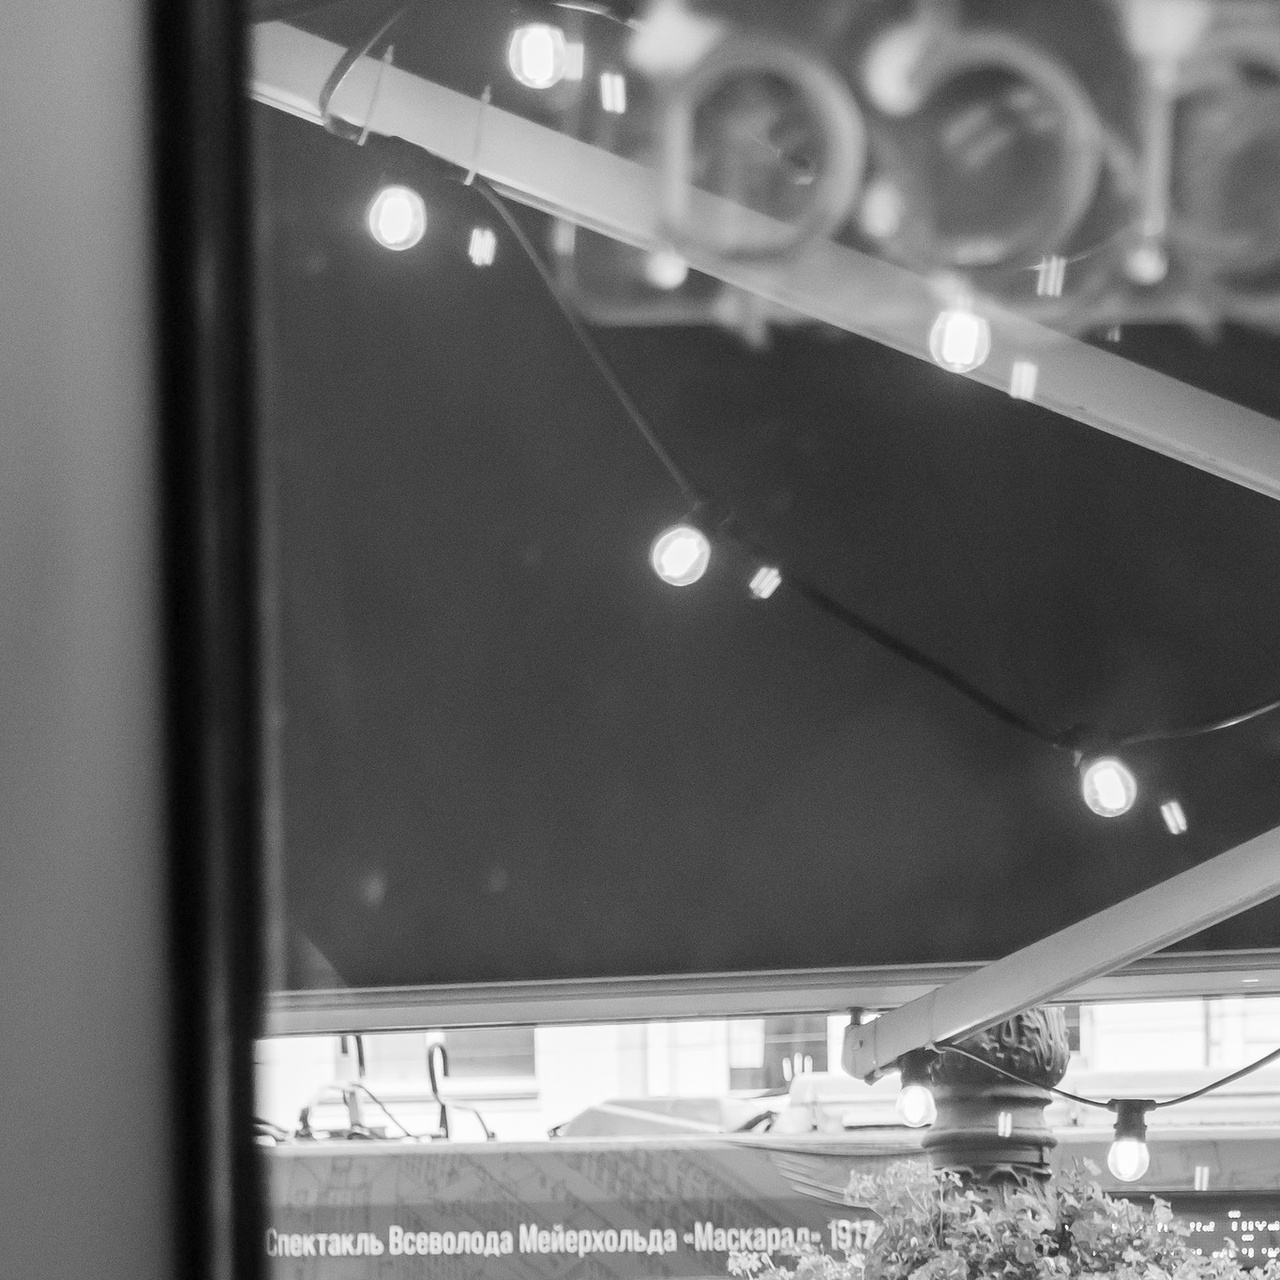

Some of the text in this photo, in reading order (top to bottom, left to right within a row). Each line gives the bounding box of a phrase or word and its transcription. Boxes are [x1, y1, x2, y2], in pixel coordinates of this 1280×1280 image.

[265, 1228, 385, 1257] Спектакль
[388, 1224, 514, 1258] Всеволода
[518, 1223, 678, 1258] Мейерхольда
